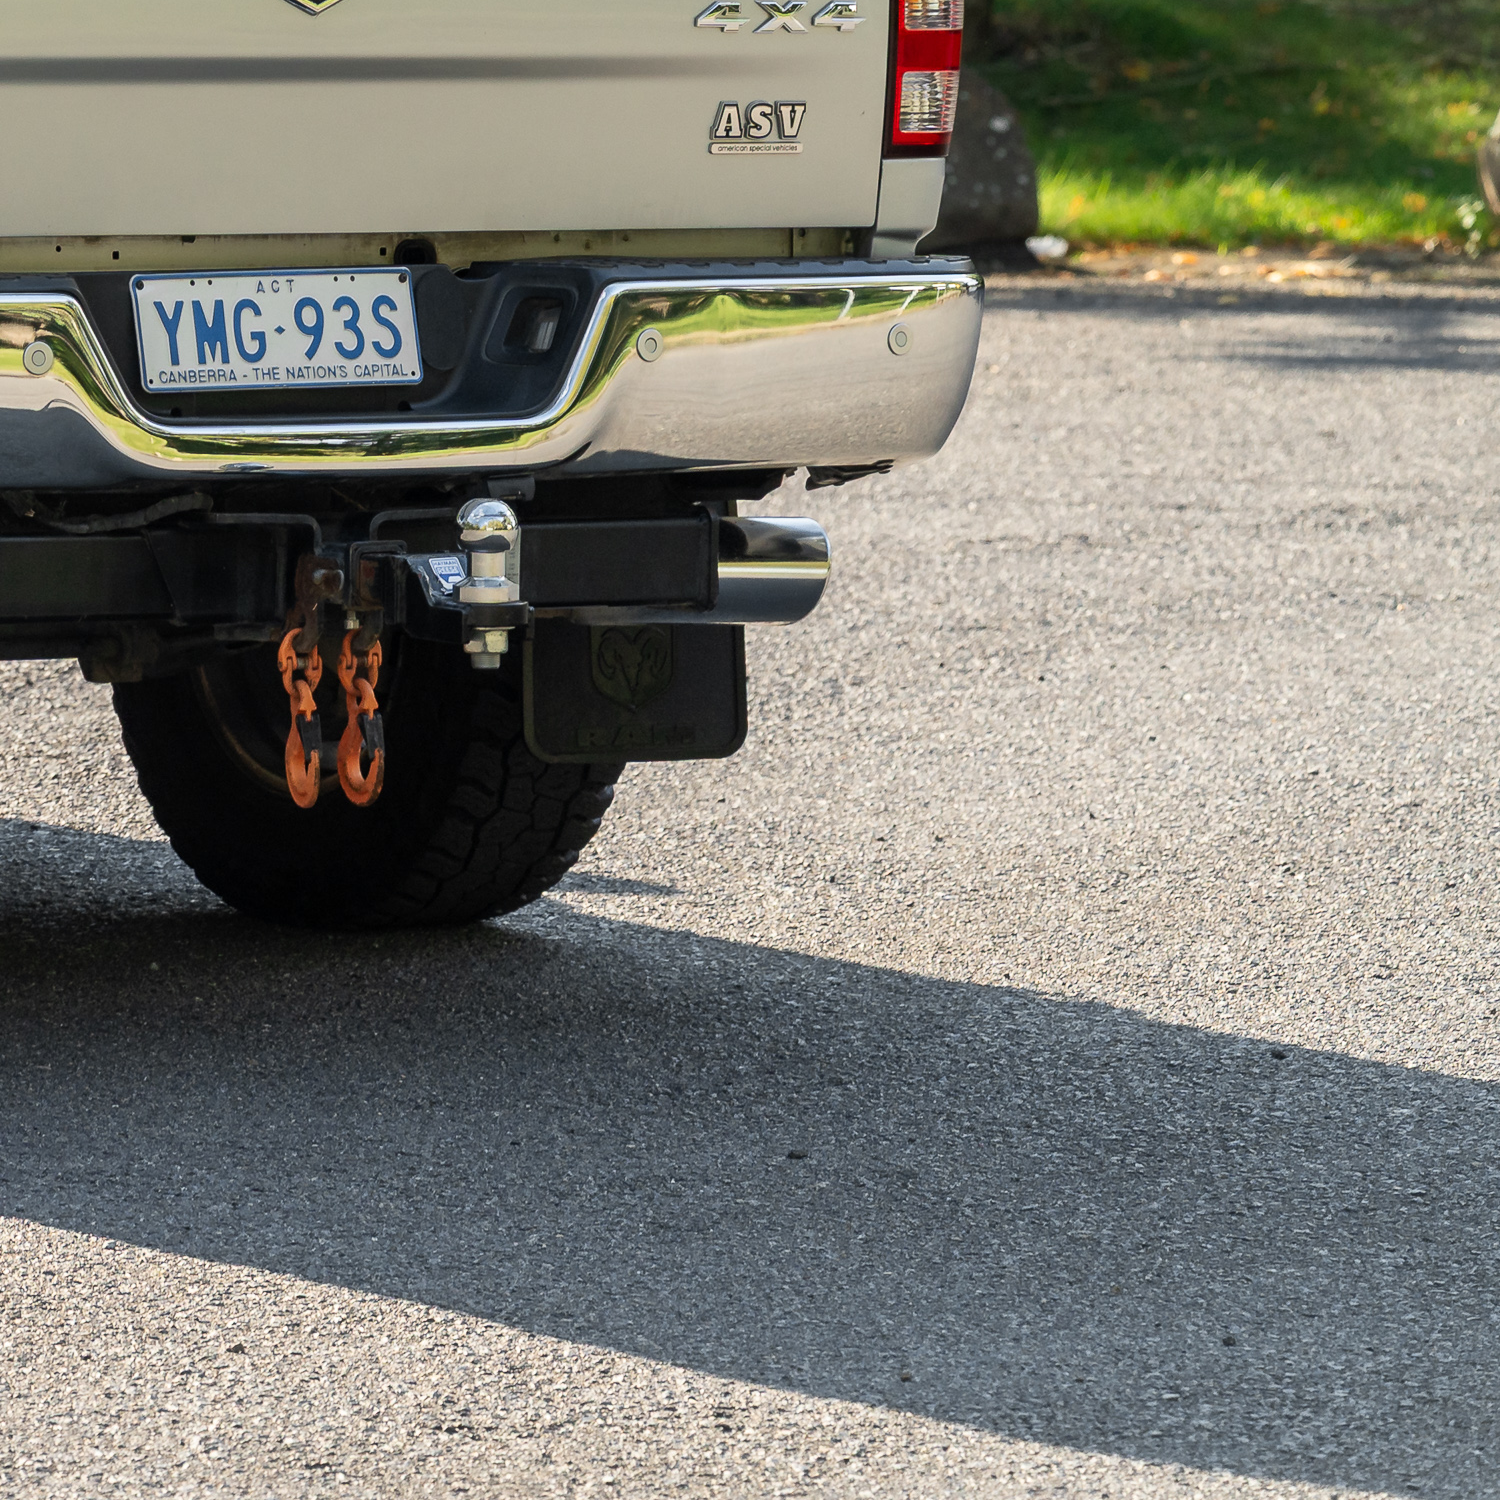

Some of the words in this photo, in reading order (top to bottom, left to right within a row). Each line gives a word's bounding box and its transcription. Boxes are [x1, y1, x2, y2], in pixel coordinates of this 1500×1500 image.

[709, 100, 807, 140] ASV
[717, 144, 748, 153] american
[749, 144, 772, 153] special
[772, 144, 798, 153] vehicles
[158, 369, 238, 385] CANBERRA
[253, 366, 280, 382] THE
[285, 363, 349, 381] NATION'S
[353, 362, 409, 378] CAPITAL
